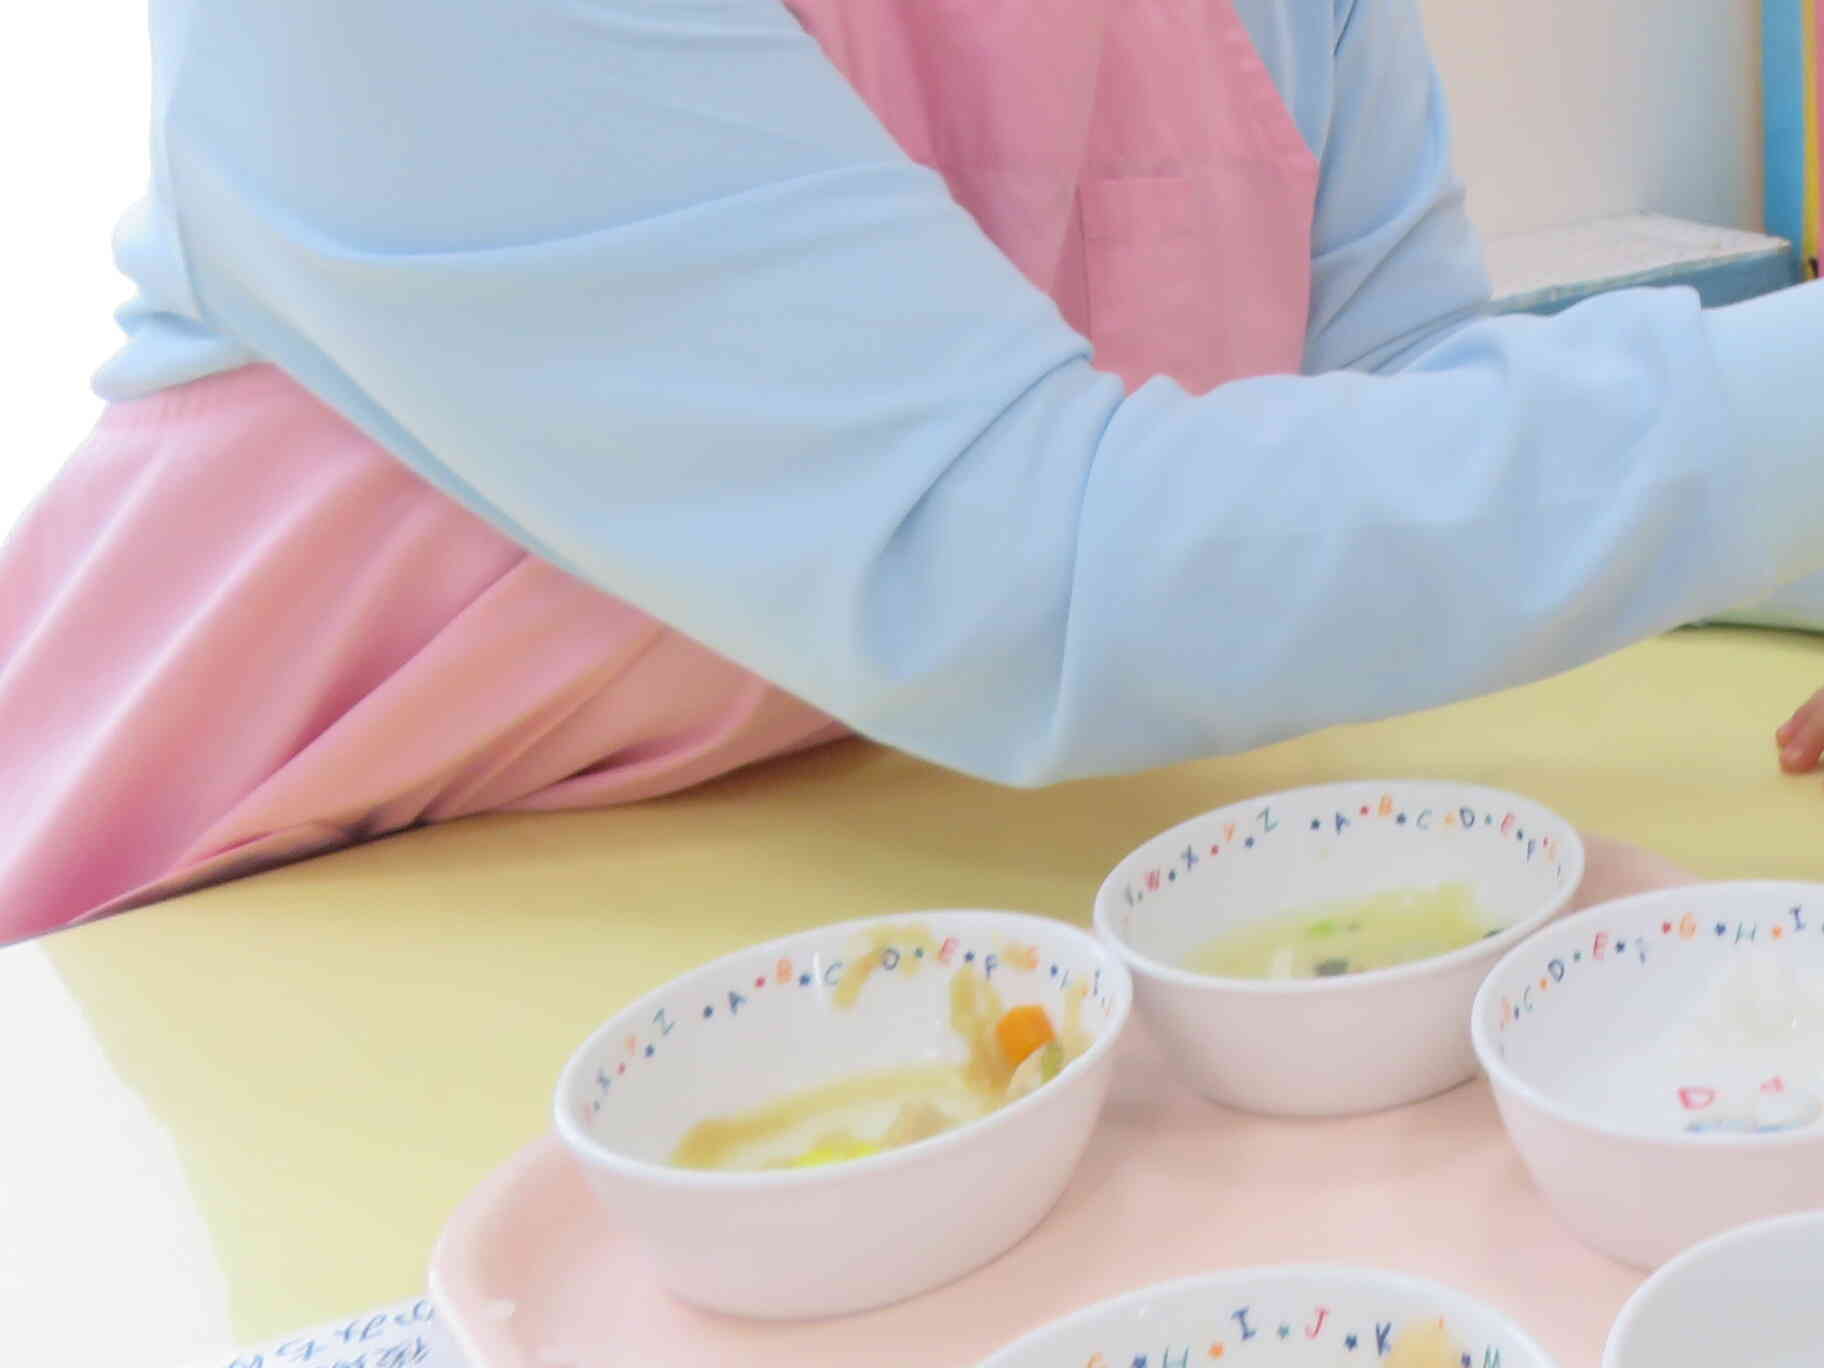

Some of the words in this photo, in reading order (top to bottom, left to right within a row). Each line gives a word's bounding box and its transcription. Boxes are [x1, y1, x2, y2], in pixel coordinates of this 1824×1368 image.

[1459, 806, 1476, 829] D
[1547, 958, 1565, 983] D
[1231, 1304, 1256, 1341] I
[1305, 1306, 1330, 1340] J
[1375, 1321, 1392, 1357] K
